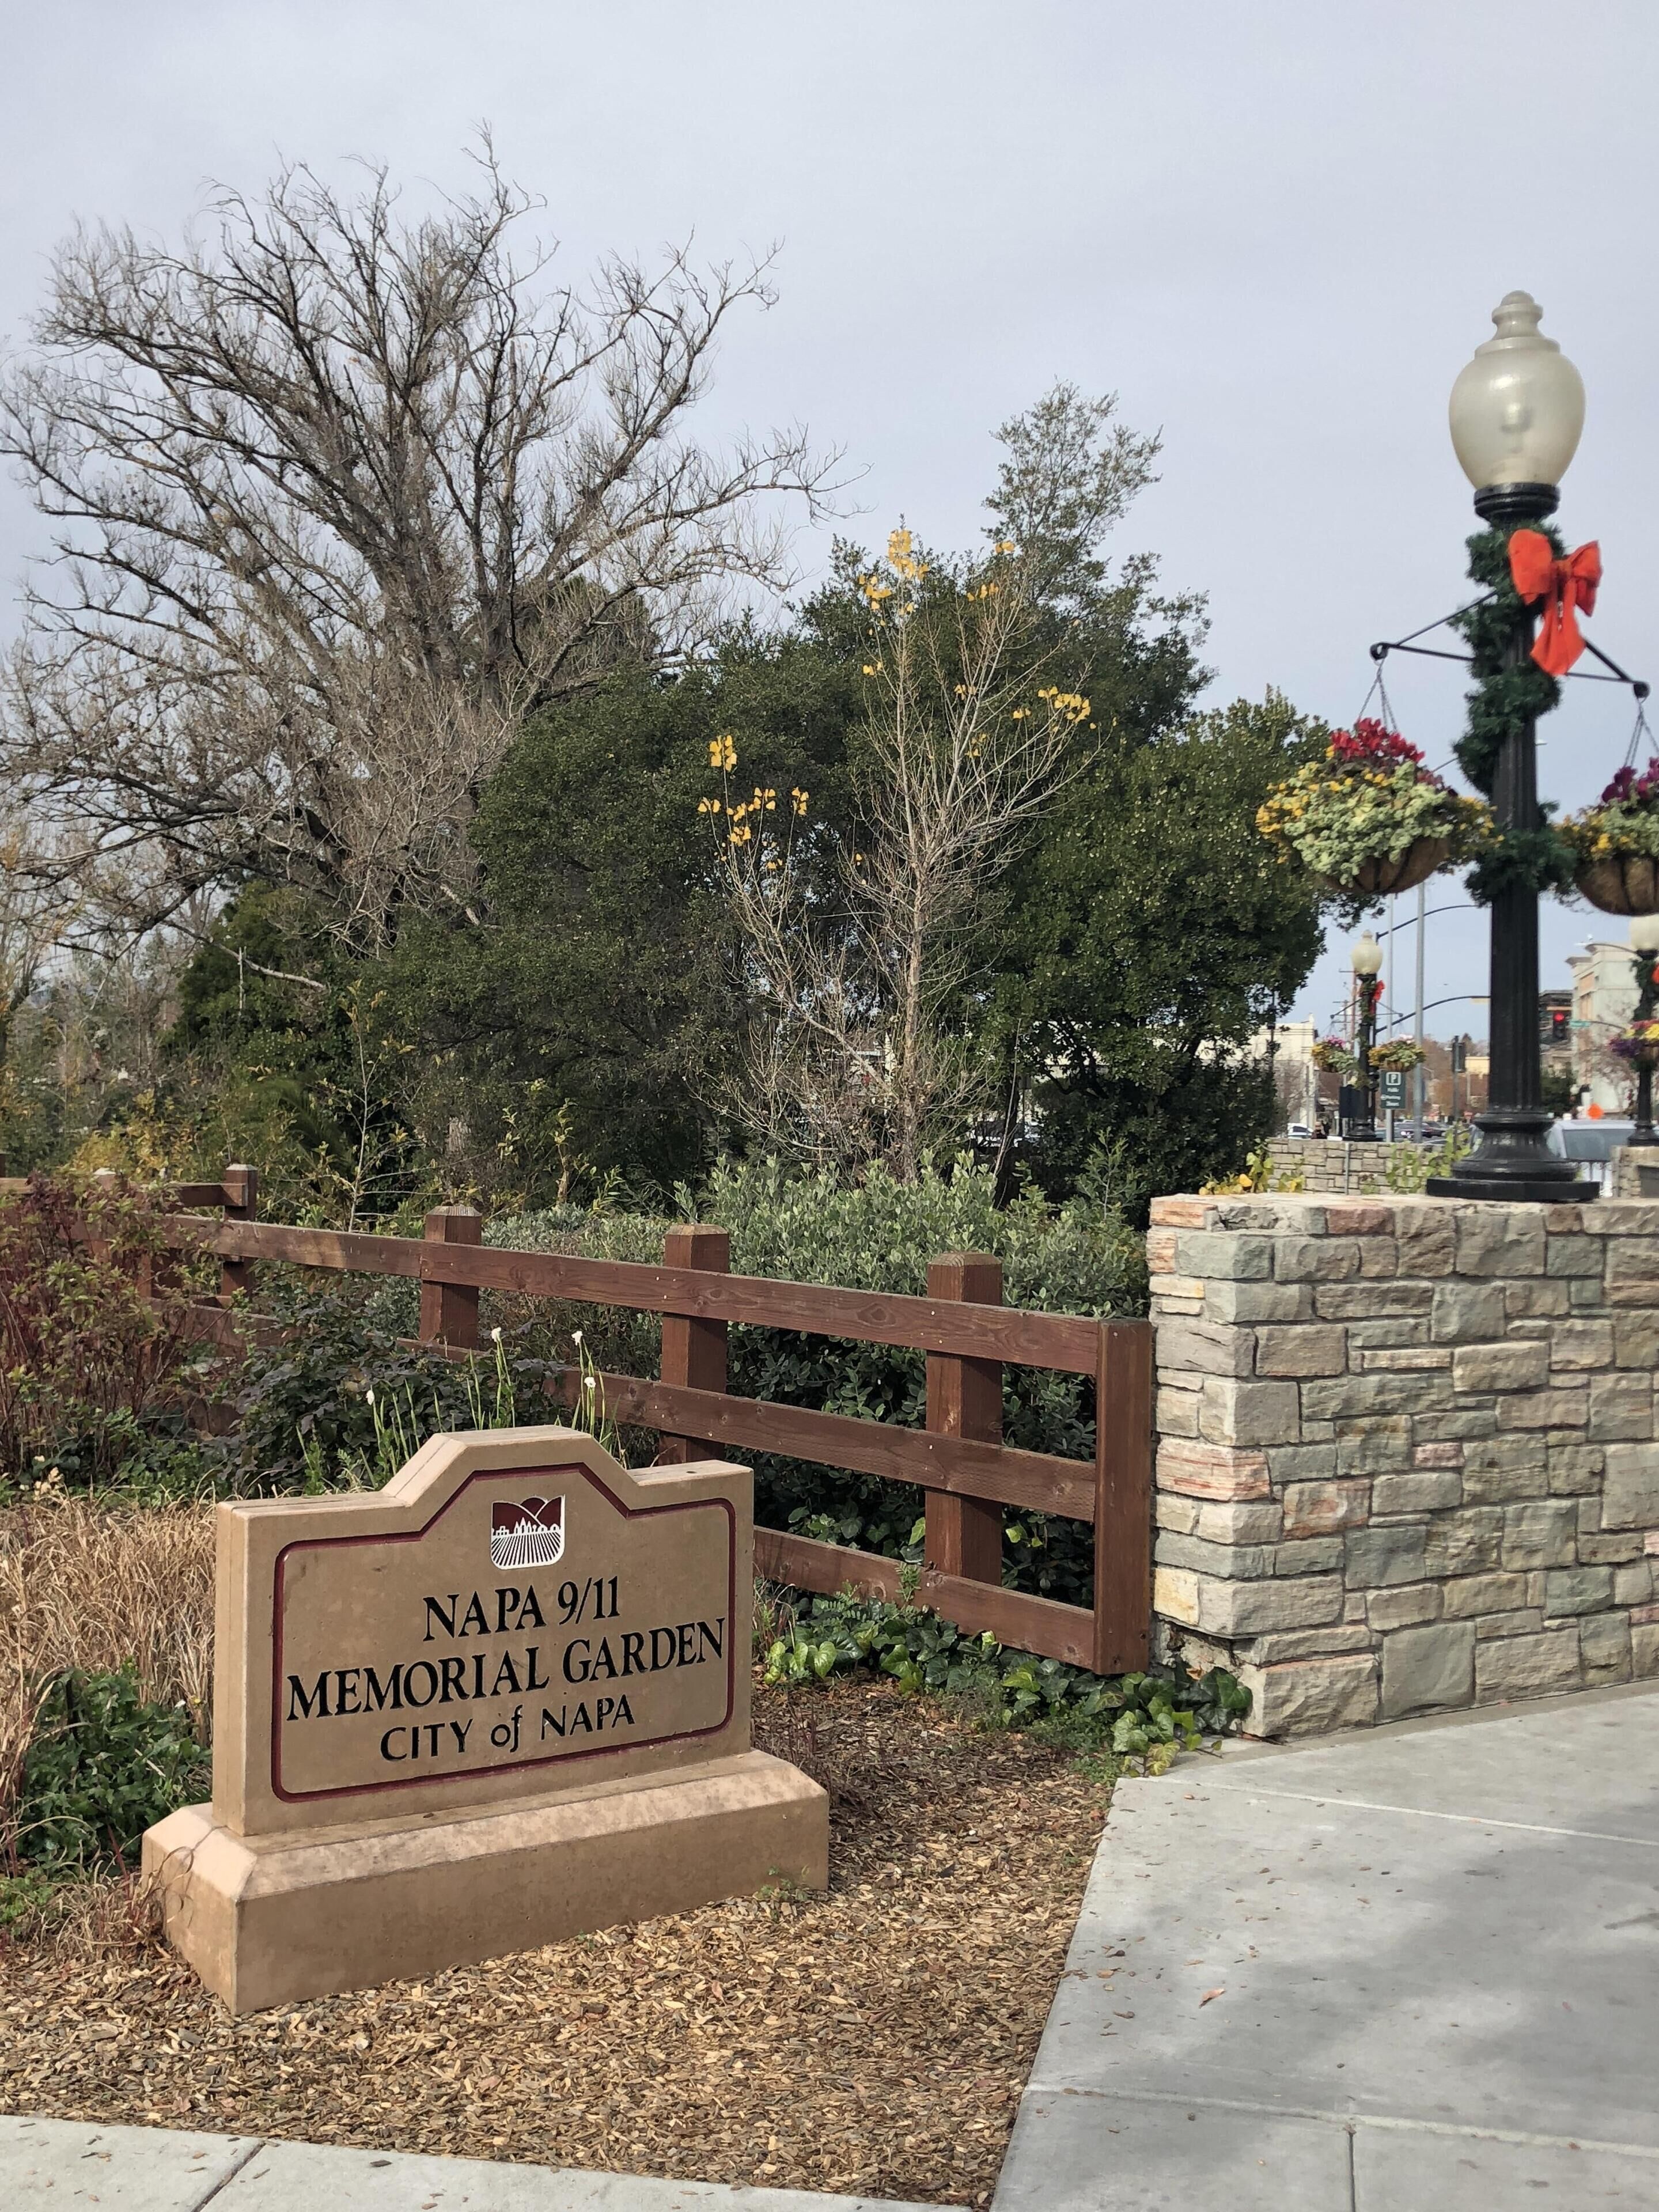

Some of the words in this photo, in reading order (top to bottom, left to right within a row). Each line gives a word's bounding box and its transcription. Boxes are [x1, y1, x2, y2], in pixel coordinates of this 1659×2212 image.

[423, 1585, 546, 1641] NAPA
[558, 1576, 620, 1625] 9/11
[287, 1647, 550, 1721] MEMORIAL
[562, 1618, 725, 1683] GARDEN
[380, 1719, 472, 1761] CITY
[491, 1705, 523, 1753] of
[541, 1694, 635, 1740] NAPA
